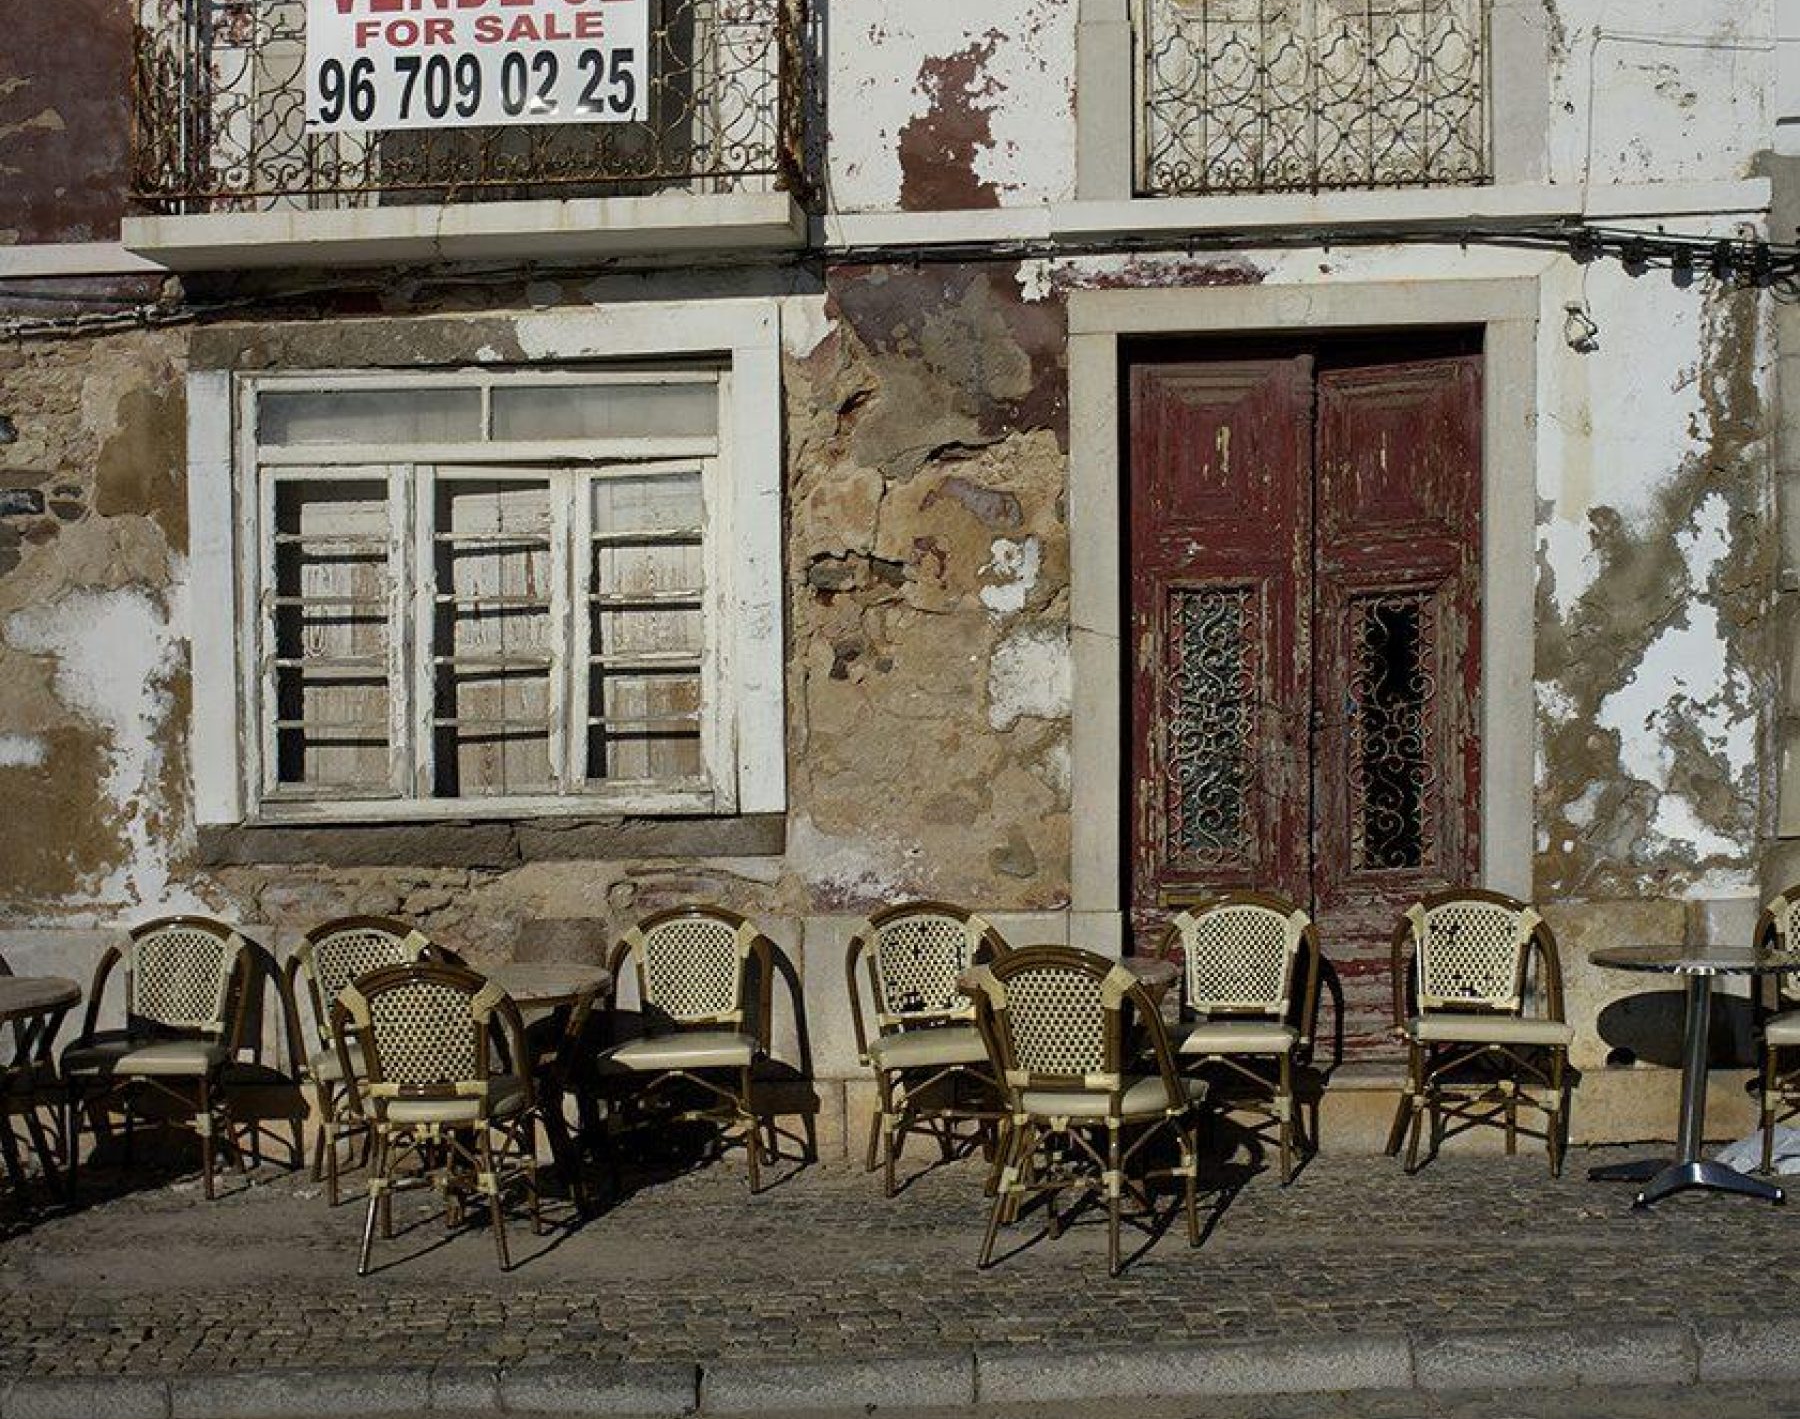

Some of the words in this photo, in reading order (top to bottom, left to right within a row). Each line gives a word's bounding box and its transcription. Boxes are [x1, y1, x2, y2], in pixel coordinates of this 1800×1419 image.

[355, 18, 456, 49] FOR
[474, 11, 604, 43] SALE
[318, 57, 375, 123] 96
[394, 52, 481, 120] 709
[502, 49, 558, 116] 02
[575, 47, 636, 113] 25
